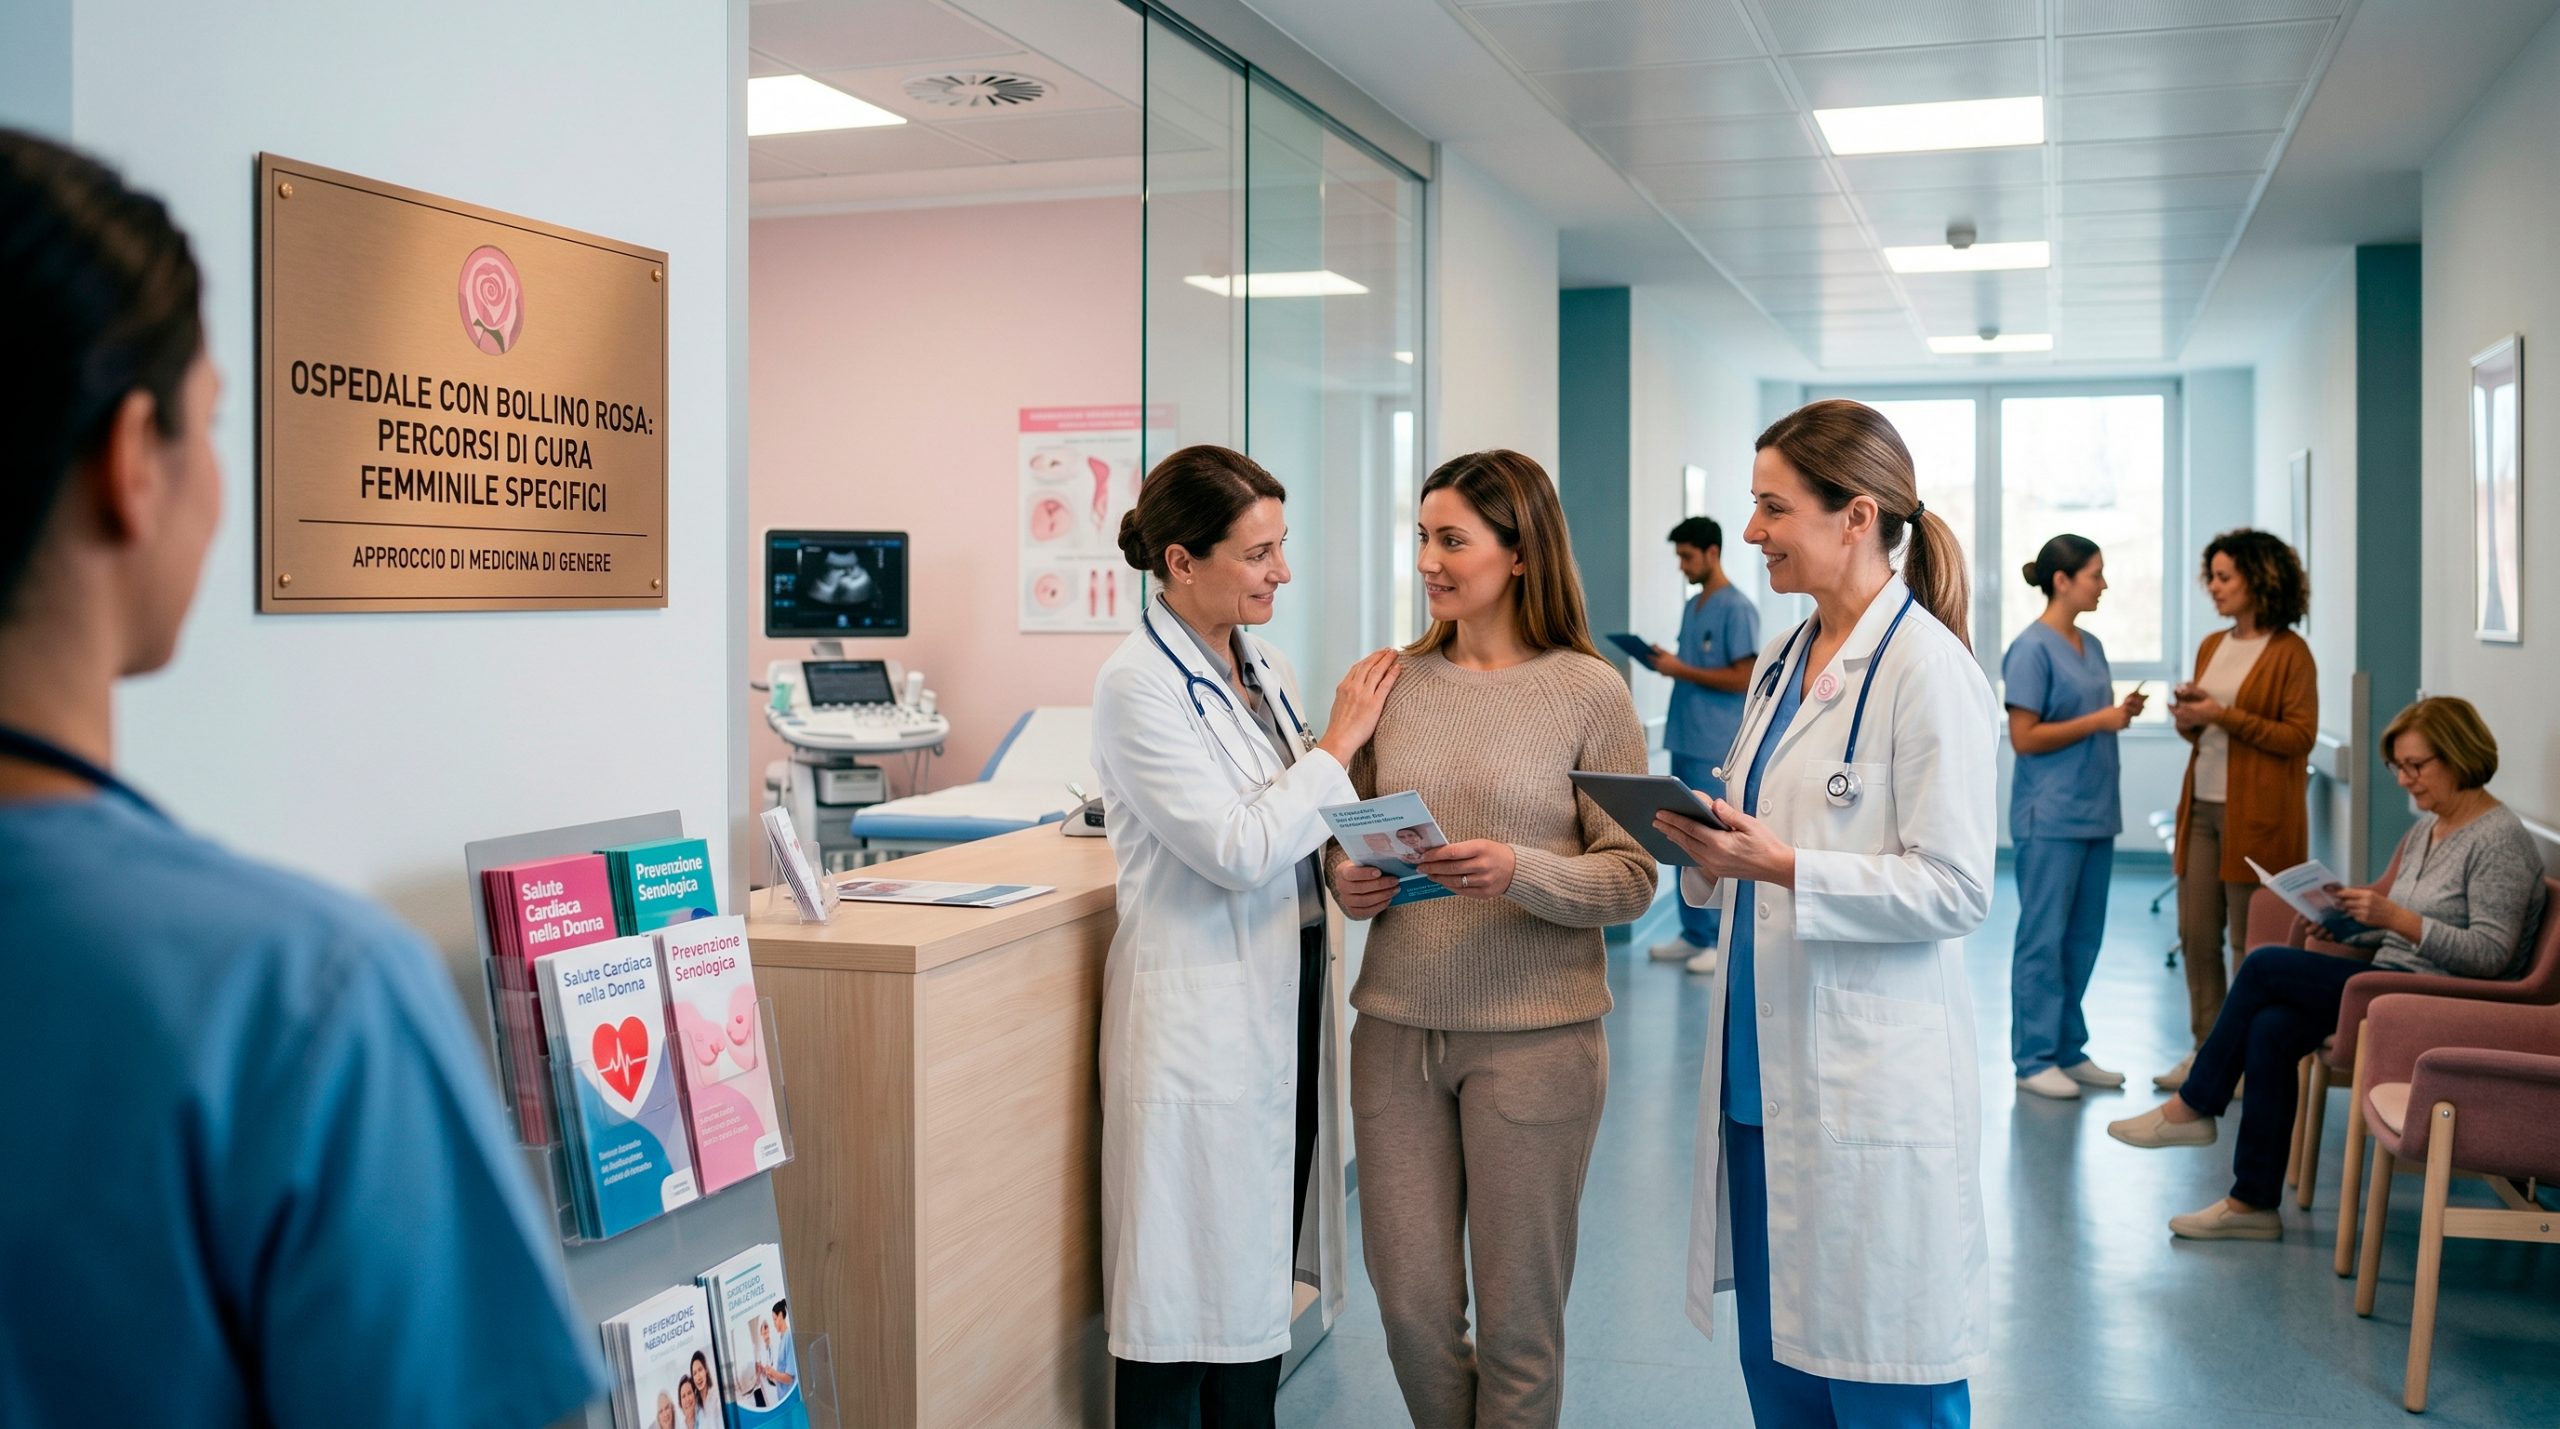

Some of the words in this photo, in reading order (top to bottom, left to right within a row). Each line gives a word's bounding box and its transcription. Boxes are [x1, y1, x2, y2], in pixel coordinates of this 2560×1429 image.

[291, 360, 432, 410] OSPEDALE
[440, 381, 489, 416] CON
[497, 387, 590, 428] BOLLINO
[595, 401, 653, 435] ROSA:
[378, 419, 499, 462] PERCORSI
[507, 432, 527, 464] DI
[535, 436, 593, 470] CURA
[361, 465, 499, 506] FEMMINILE
[505, 476, 607, 513] SPECIFICI
[353, 546, 446, 569] APPROCCIO
[450, 549, 465, 570] DI
[469, 550, 540, 571] MEDICINA
[543, 551, 556, 571] DI
[559, 552, 611, 572] GENERE
[635, 855, 703, 880] Prevenzione
[522, 878, 564, 900] Salute
[638, 877, 699, 901] Senologica
[525, 898, 581, 922] Cardiaca
[528, 922, 561, 945] nella
[562, 915, 604, 940] Donna
[671, 932, 741, 961] Prevenzione
[563, 965, 601, 988] Salute
[603, 954, 653, 977] Cardiaca
[675, 955, 736, 982] Senologica
[577, 985, 607, 1007] nella
[608, 976, 646, 998] Donna
